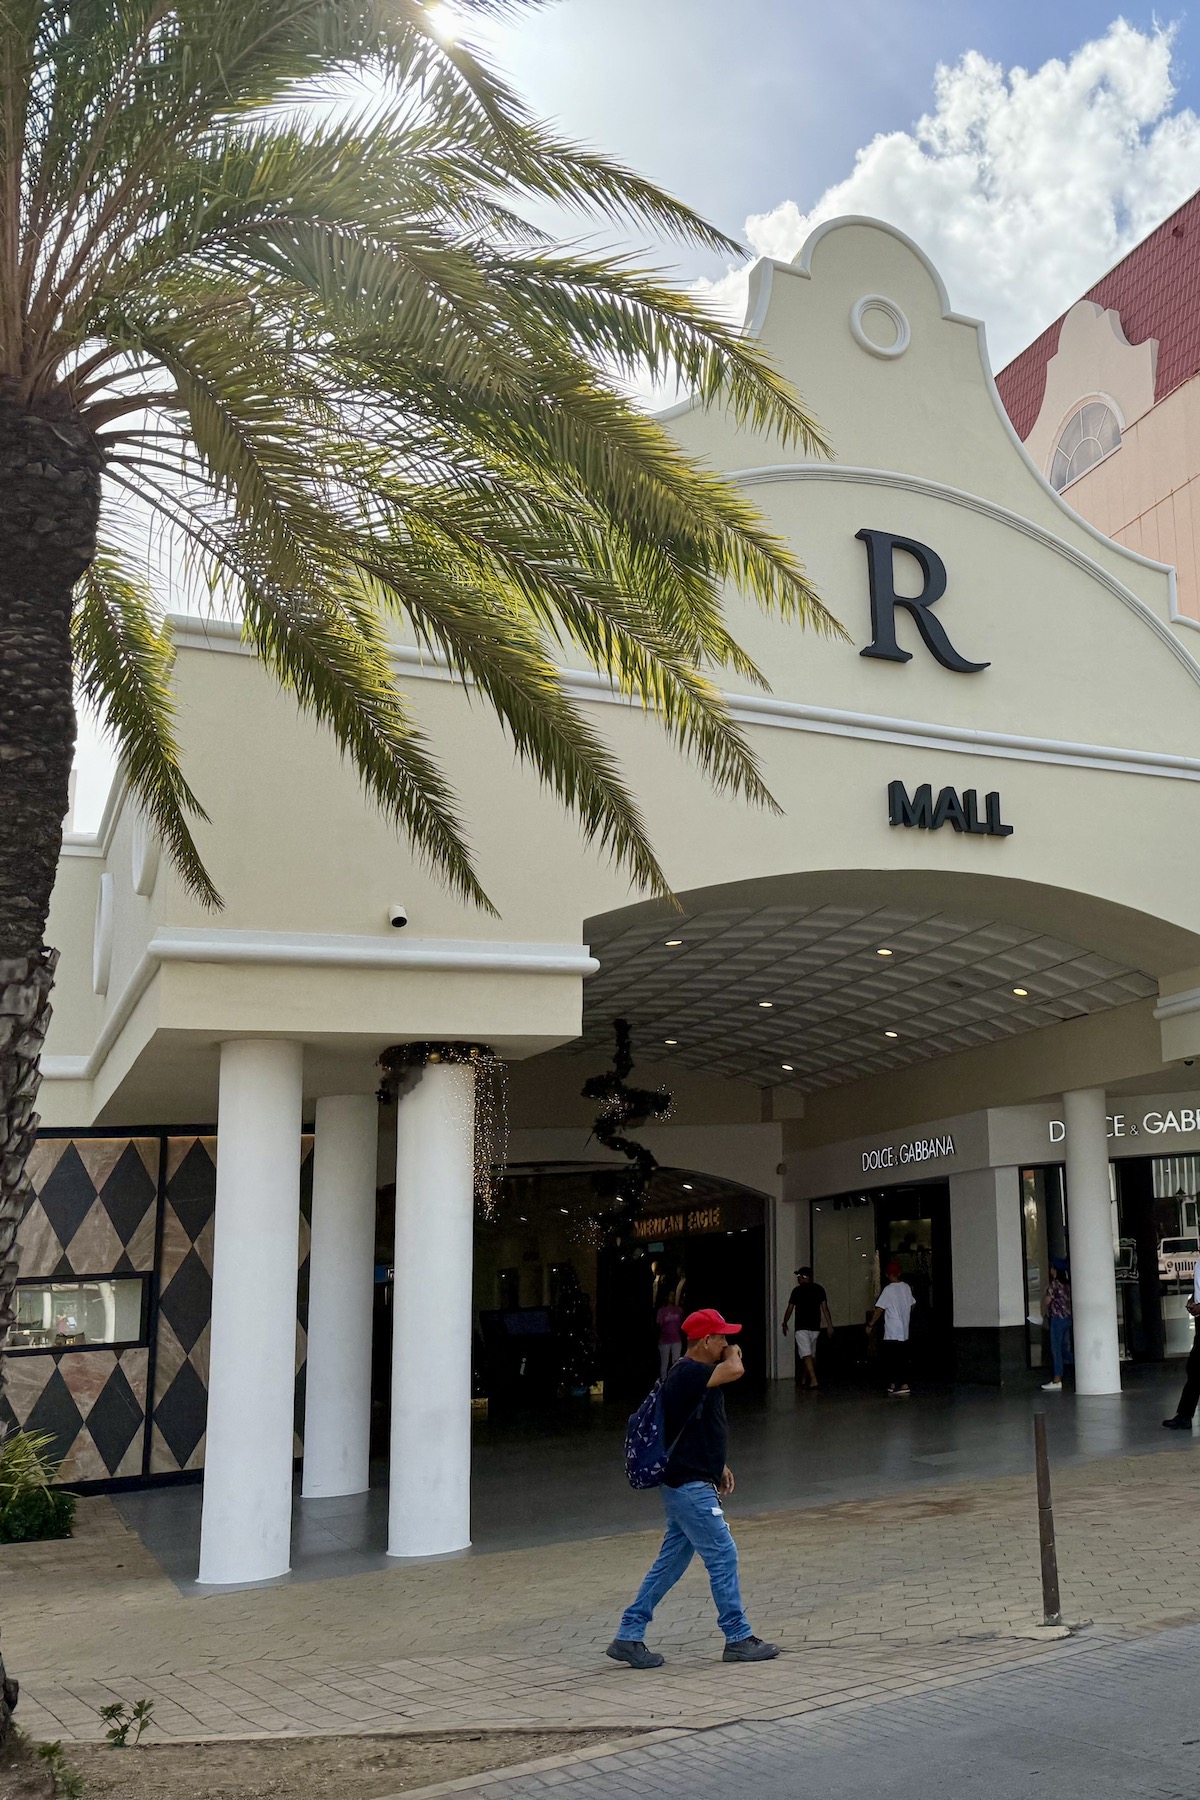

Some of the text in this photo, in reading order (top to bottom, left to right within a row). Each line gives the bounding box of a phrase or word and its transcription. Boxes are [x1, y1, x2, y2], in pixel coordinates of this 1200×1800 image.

[855, 528, 991, 673] R
[887, 780, 1013, 838] MALL
[862, 1147, 894, 1172] DOLCE
[899, 1135, 955, 1164] GABBANA
